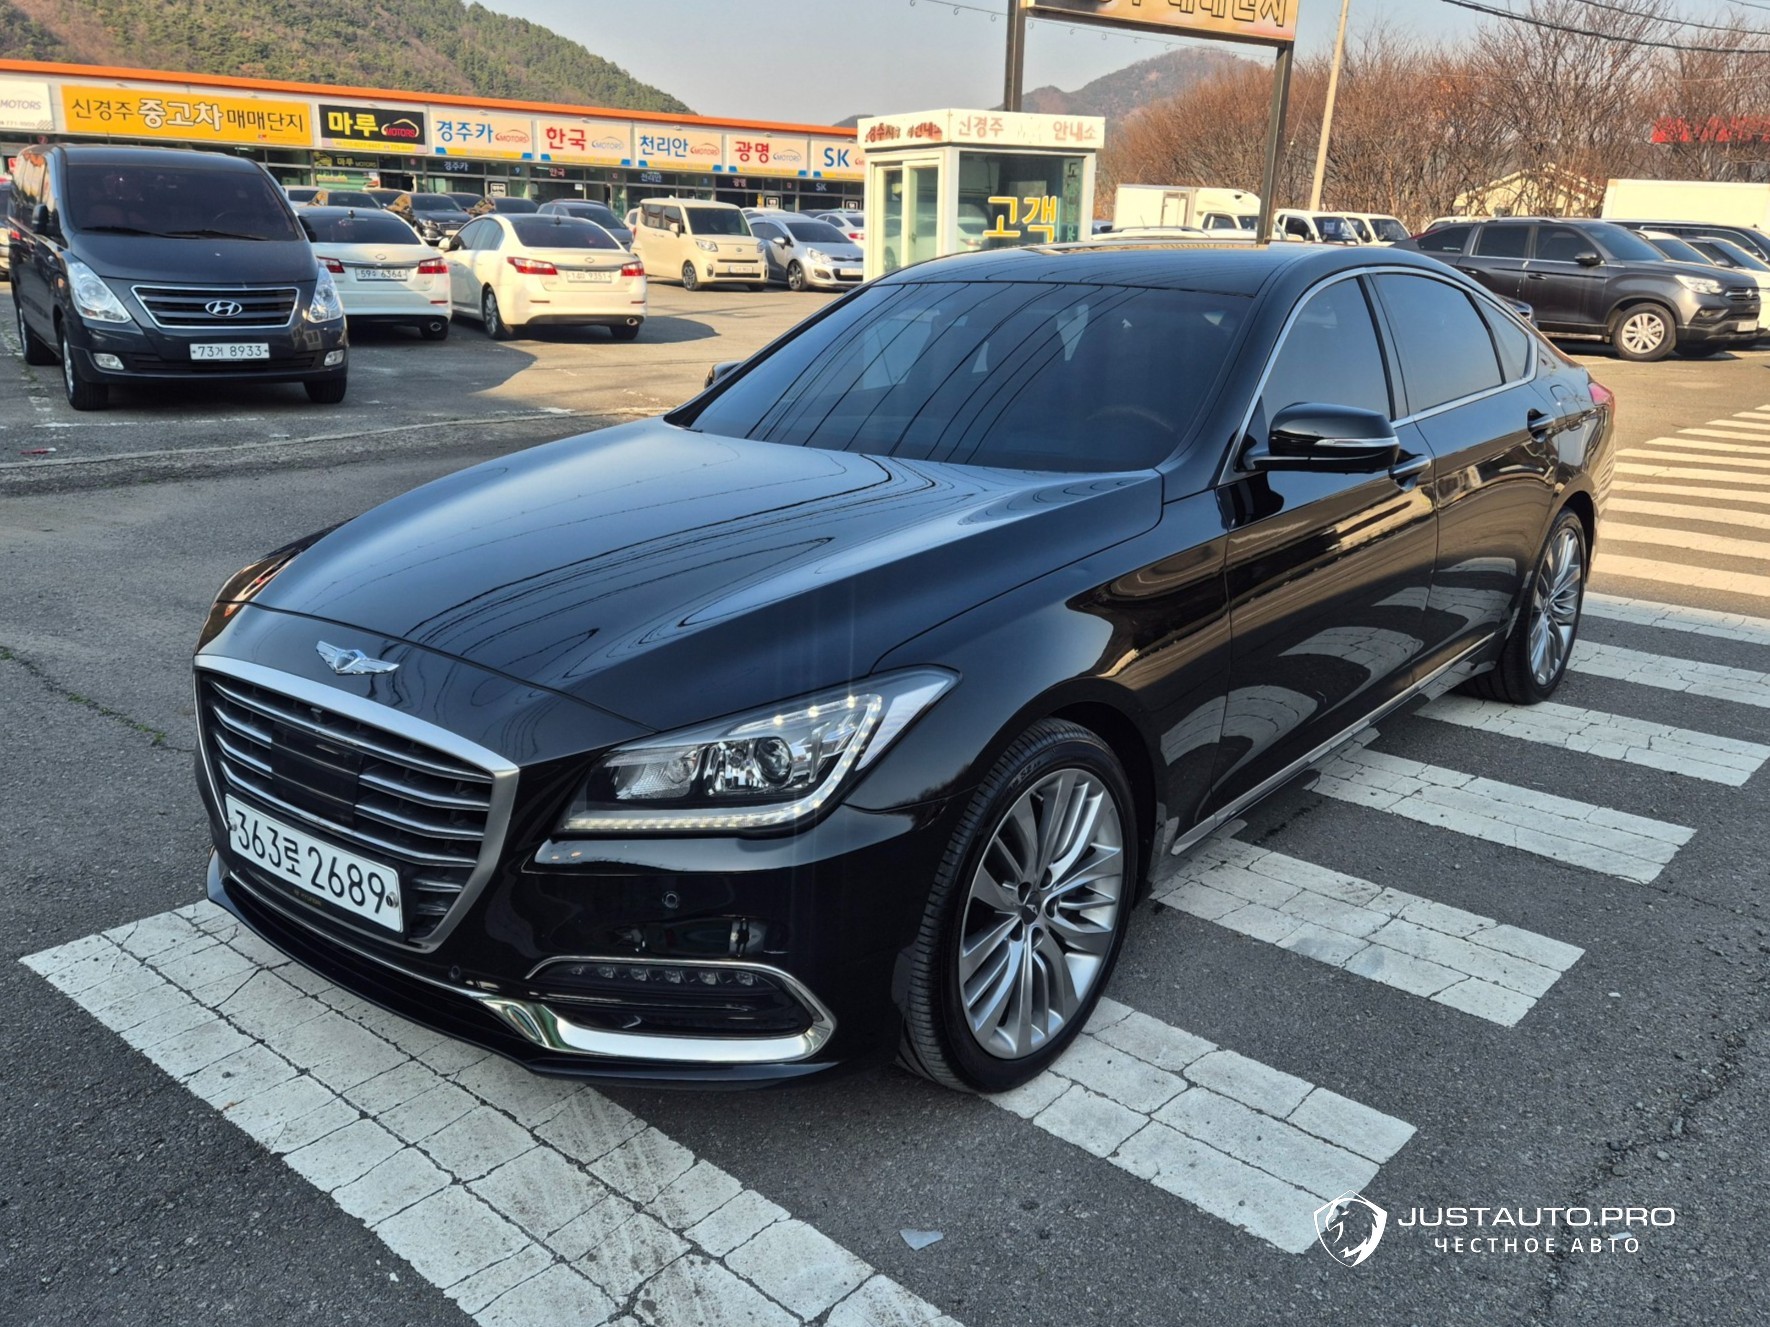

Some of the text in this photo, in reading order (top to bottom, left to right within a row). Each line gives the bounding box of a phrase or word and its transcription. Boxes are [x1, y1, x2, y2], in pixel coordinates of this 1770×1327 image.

[71, 97, 304, 133] 신경주 중고차 매매단지
[327, 111, 416, 138] 마루 MOTORS
[436, 120, 528, 143] 경주카 MOTORS
[546, 127, 624, 151] 한국 MOTORS
[958, 115, 1097, 142] 신경주 안내소
[640, 135, 689, 157] 천리안
[735, 141, 769, 164] 광명
[824, 147, 850, 168] SK
[443, 161, 469, 172] 경주카
[982, 195, 1057, 244] 고객
[230, 345, 262, 357] 8933
